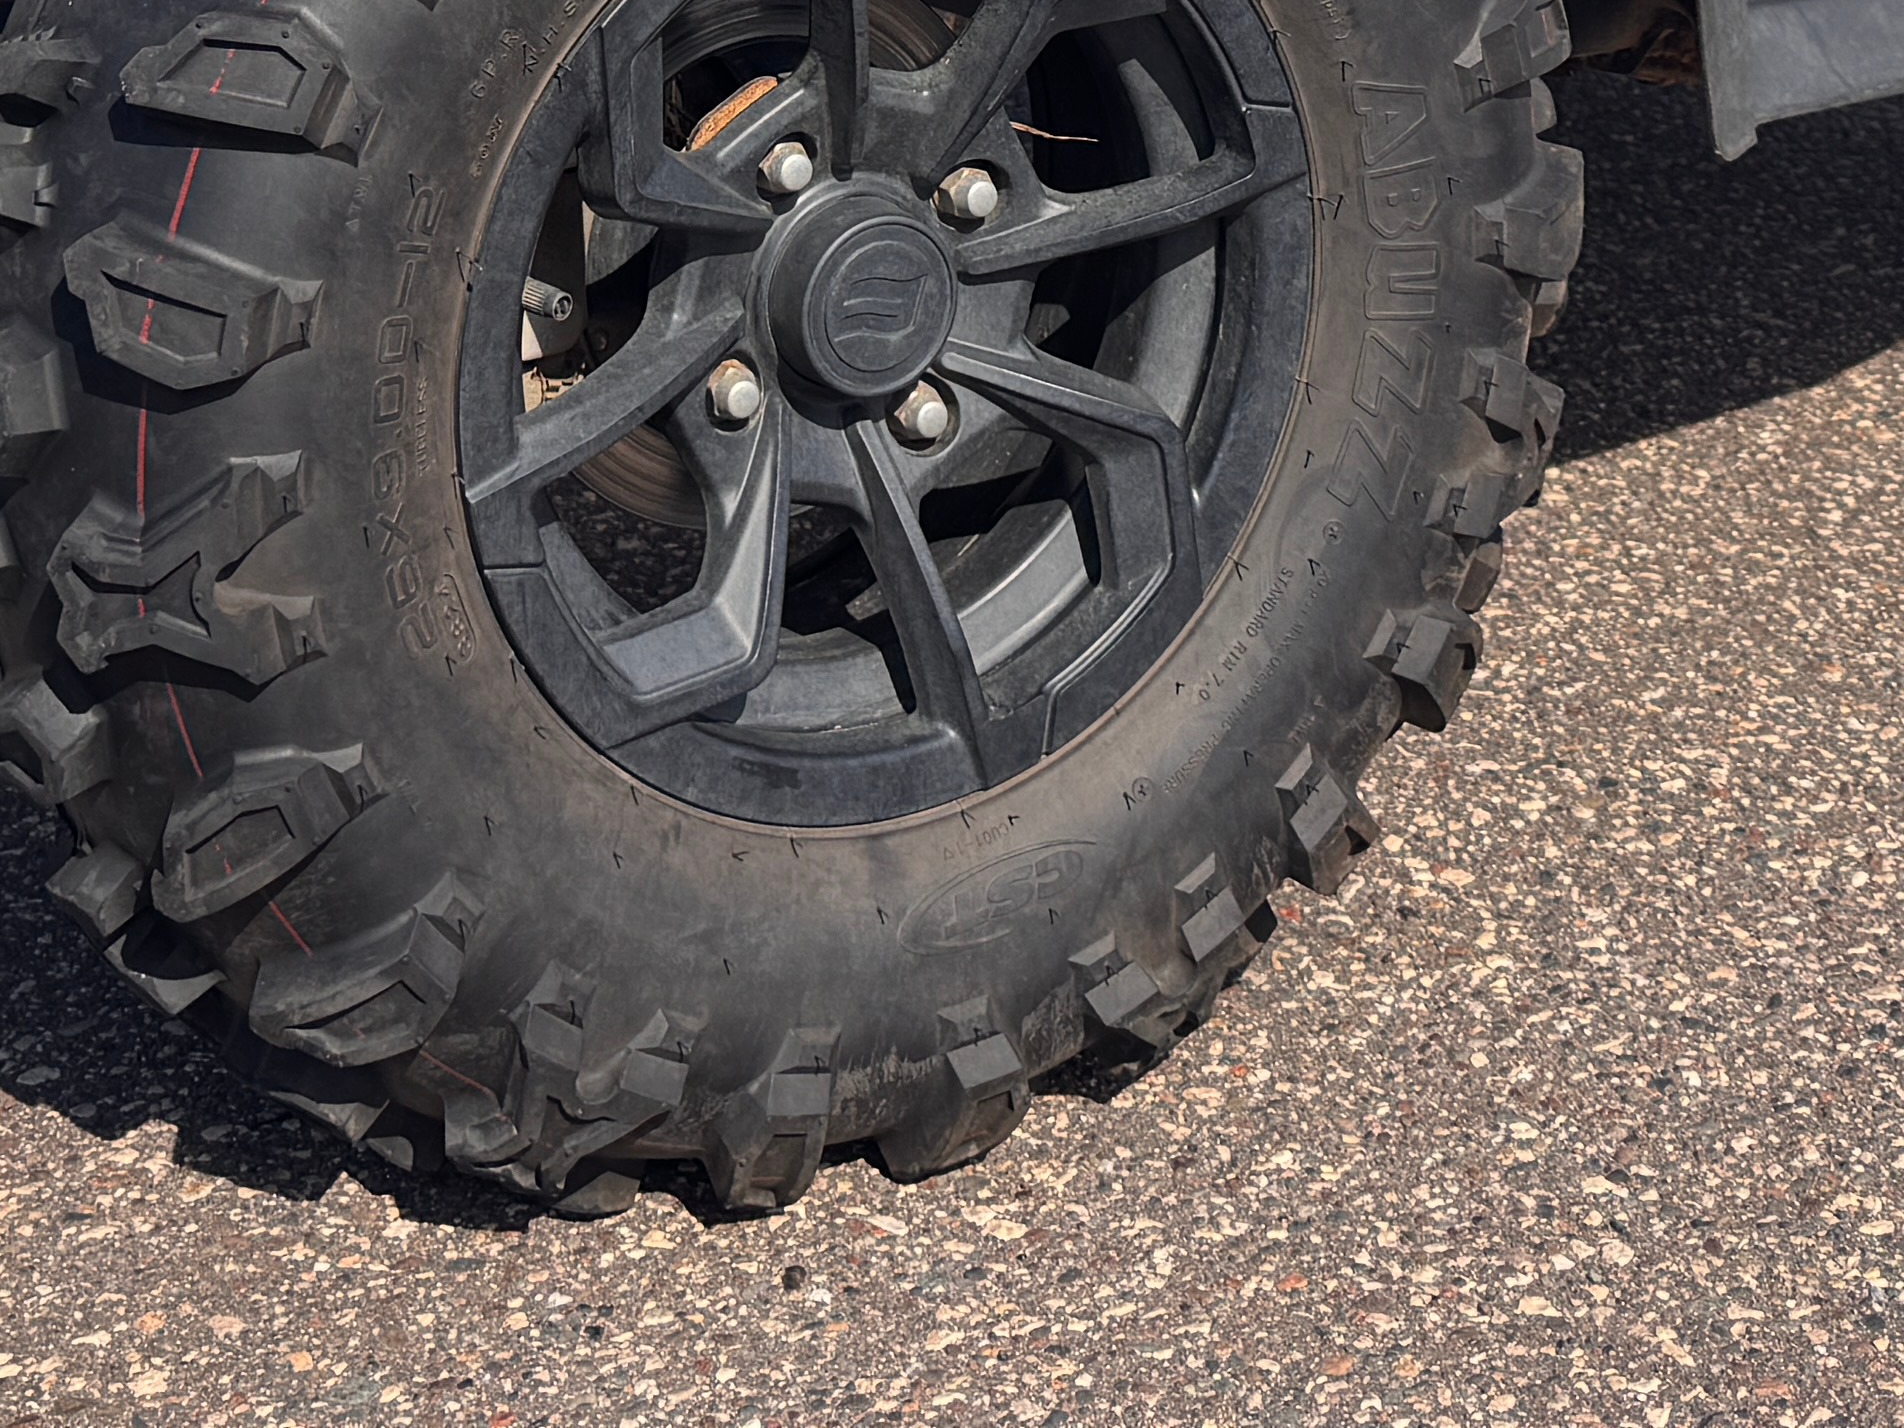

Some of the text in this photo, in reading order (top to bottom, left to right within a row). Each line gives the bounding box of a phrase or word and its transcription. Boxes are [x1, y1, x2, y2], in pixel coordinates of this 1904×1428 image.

[1326, 79, 1441, 523] ABUZZ
[370, 184, 447, 660] 26X9.00-12
[414, 375, 432, 476] TUBELESS
[1195, 566, 1295, 704] STANDARD RIM 7.0
[1218, 653, 1283, 735] OPERATING
[1159, 732, 1221, 796] PRESSURE
[943, 848, 1084, 930] CST
